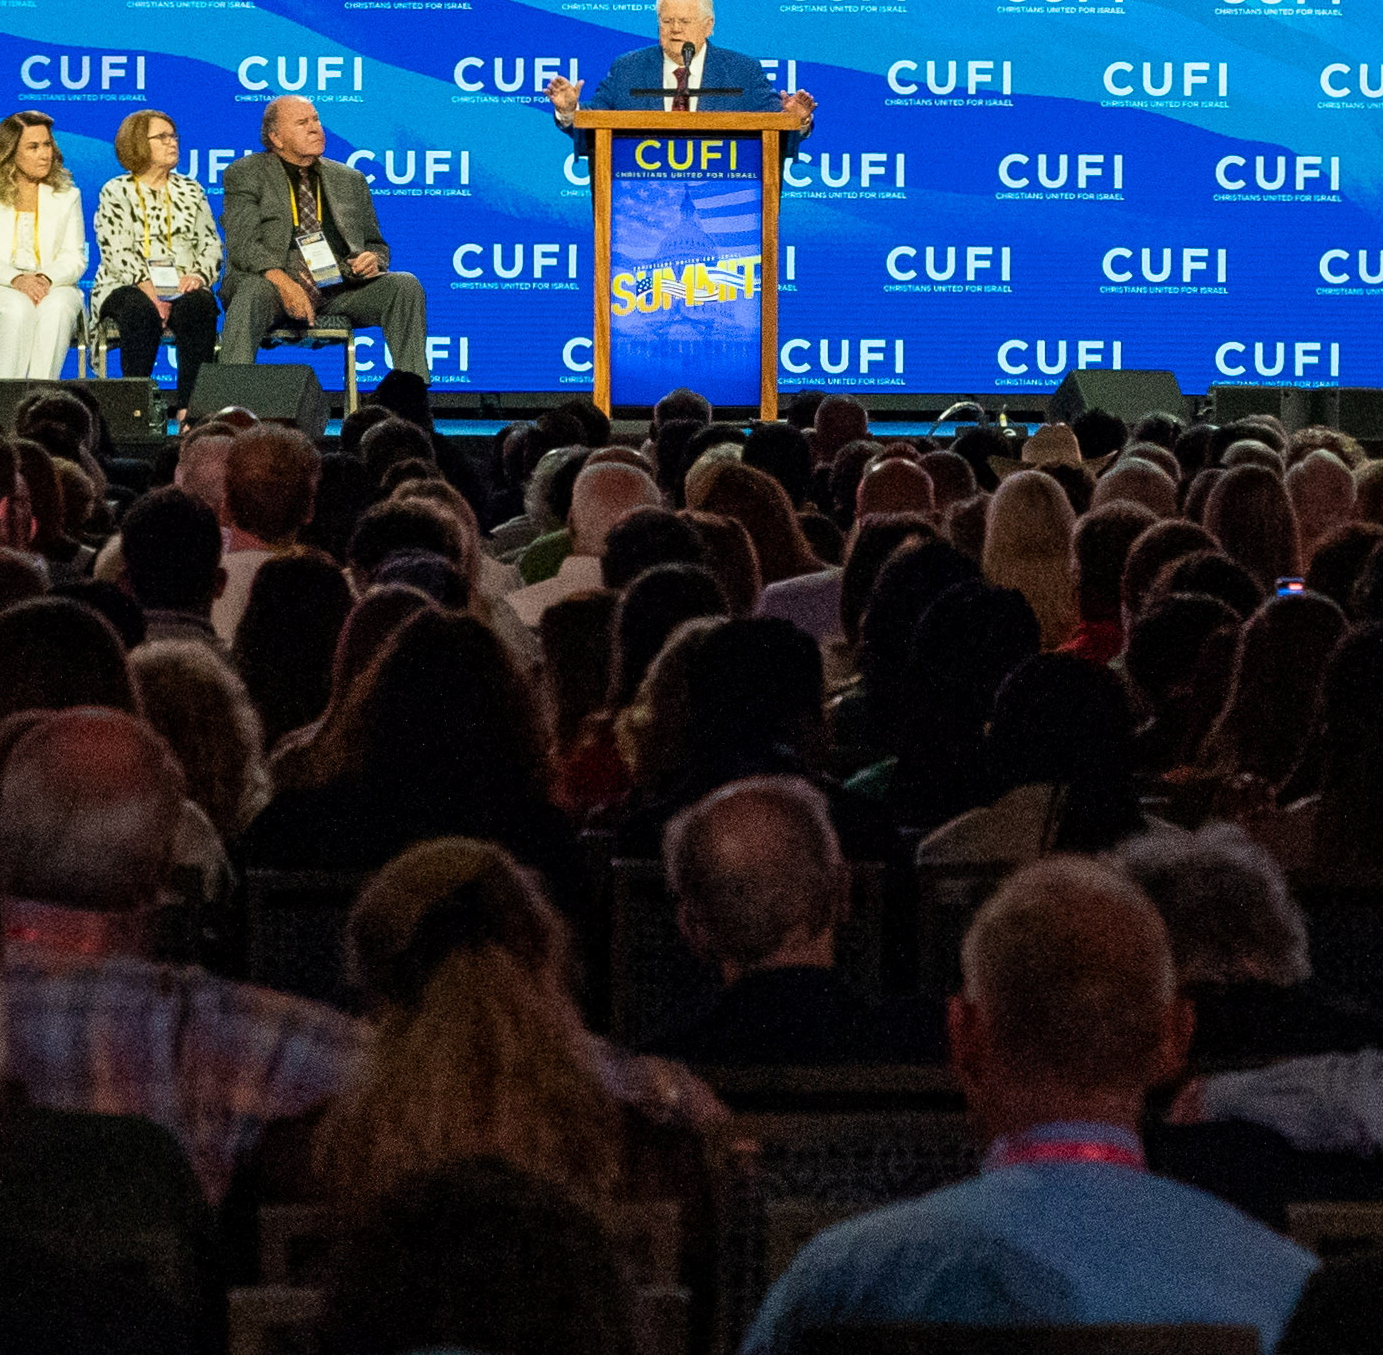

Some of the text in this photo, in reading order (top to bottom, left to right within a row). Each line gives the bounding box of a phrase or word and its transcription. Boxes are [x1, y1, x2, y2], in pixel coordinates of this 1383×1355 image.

[20, 55, 146, 90] CUFI
[238, 57, 362, 92] CUFI
[453, 58, 578, 93] CUFI
[888, 61, 1012, 96] CUFI
[1104, 62, 1228, 97] CUFI
[635, 139, 737, 170] CUFI
[783, 152, 905, 187] CUFI
[998, 154, 1122, 189] CUFI
[615, 171, 668, 179] CHRISTIANS
[670, 171, 703, 179] UNITED
[727, 171, 758, 179] ISRAEL
[1216, 156, 1340, 190] CUFI
[452, 244, 578, 279] CUFI
[886, 246, 1010, 281] CUFI
[1102, 248, 1226, 283] CUFI
[450, 282, 498, 290] CHRISTIANS
[500, 282, 530, 290] UNITED
[611, 255, 762, 317] SUMMIT
[1100, 286, 1148, 294] CHRISTIANS
[1150, 286, 1179, 294] UNITED
[1200, 286, 1228, 294] ISRAEL
[354, 336, 468, 371] CFI
[780, 338, 905, 373] CUFI
[998, 340, 1122, 375] CUFI
[1216, 341, 1340, 376] CUFI
